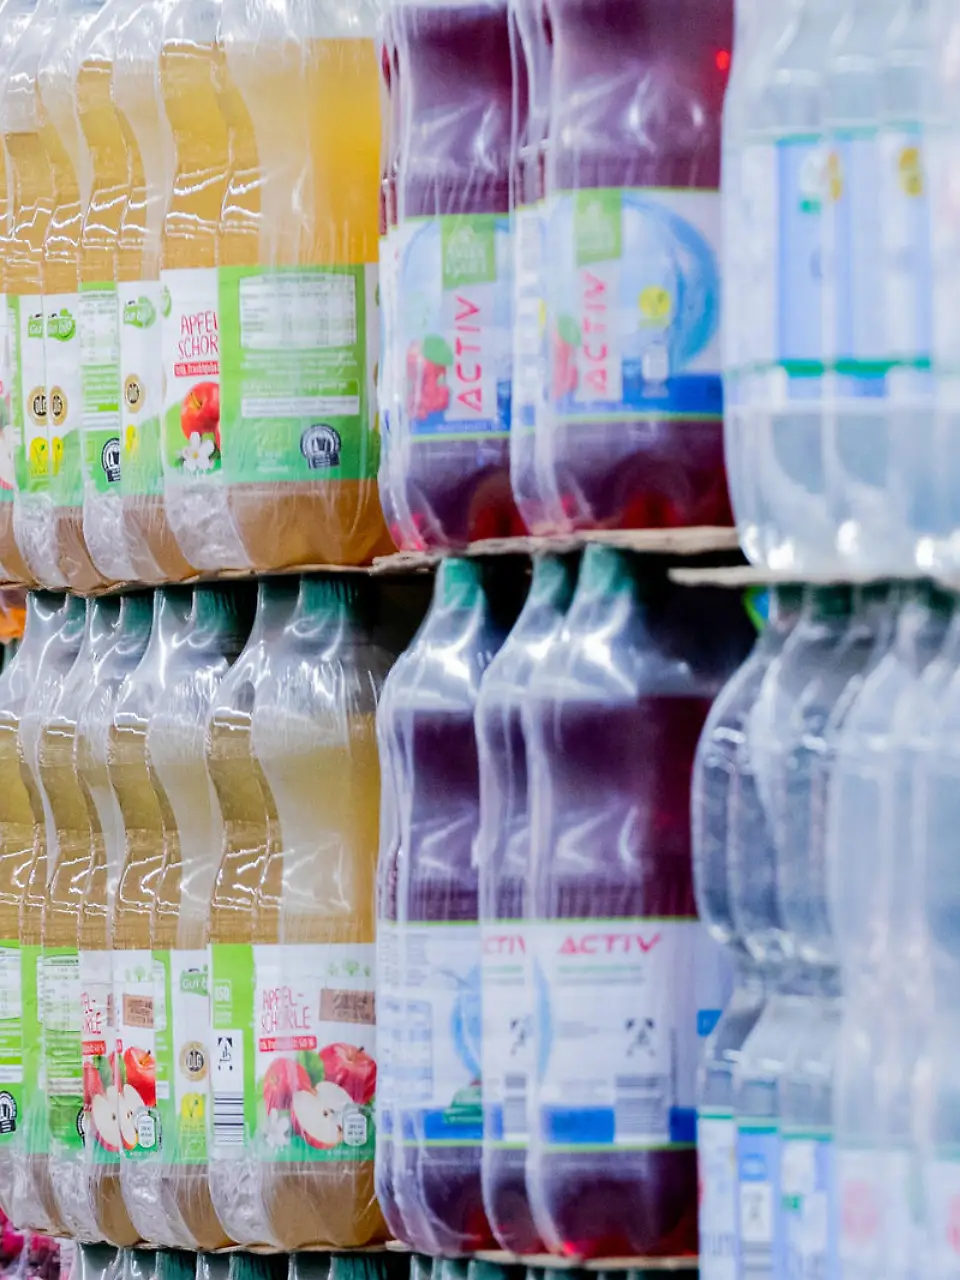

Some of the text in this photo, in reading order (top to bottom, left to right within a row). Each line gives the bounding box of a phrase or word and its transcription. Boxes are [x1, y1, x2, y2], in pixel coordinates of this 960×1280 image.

[455, 295, 482, 413] ACTIV
[583, 270, 608, 394] ACTIV
[557, 932, 662, 955] ACTIV
